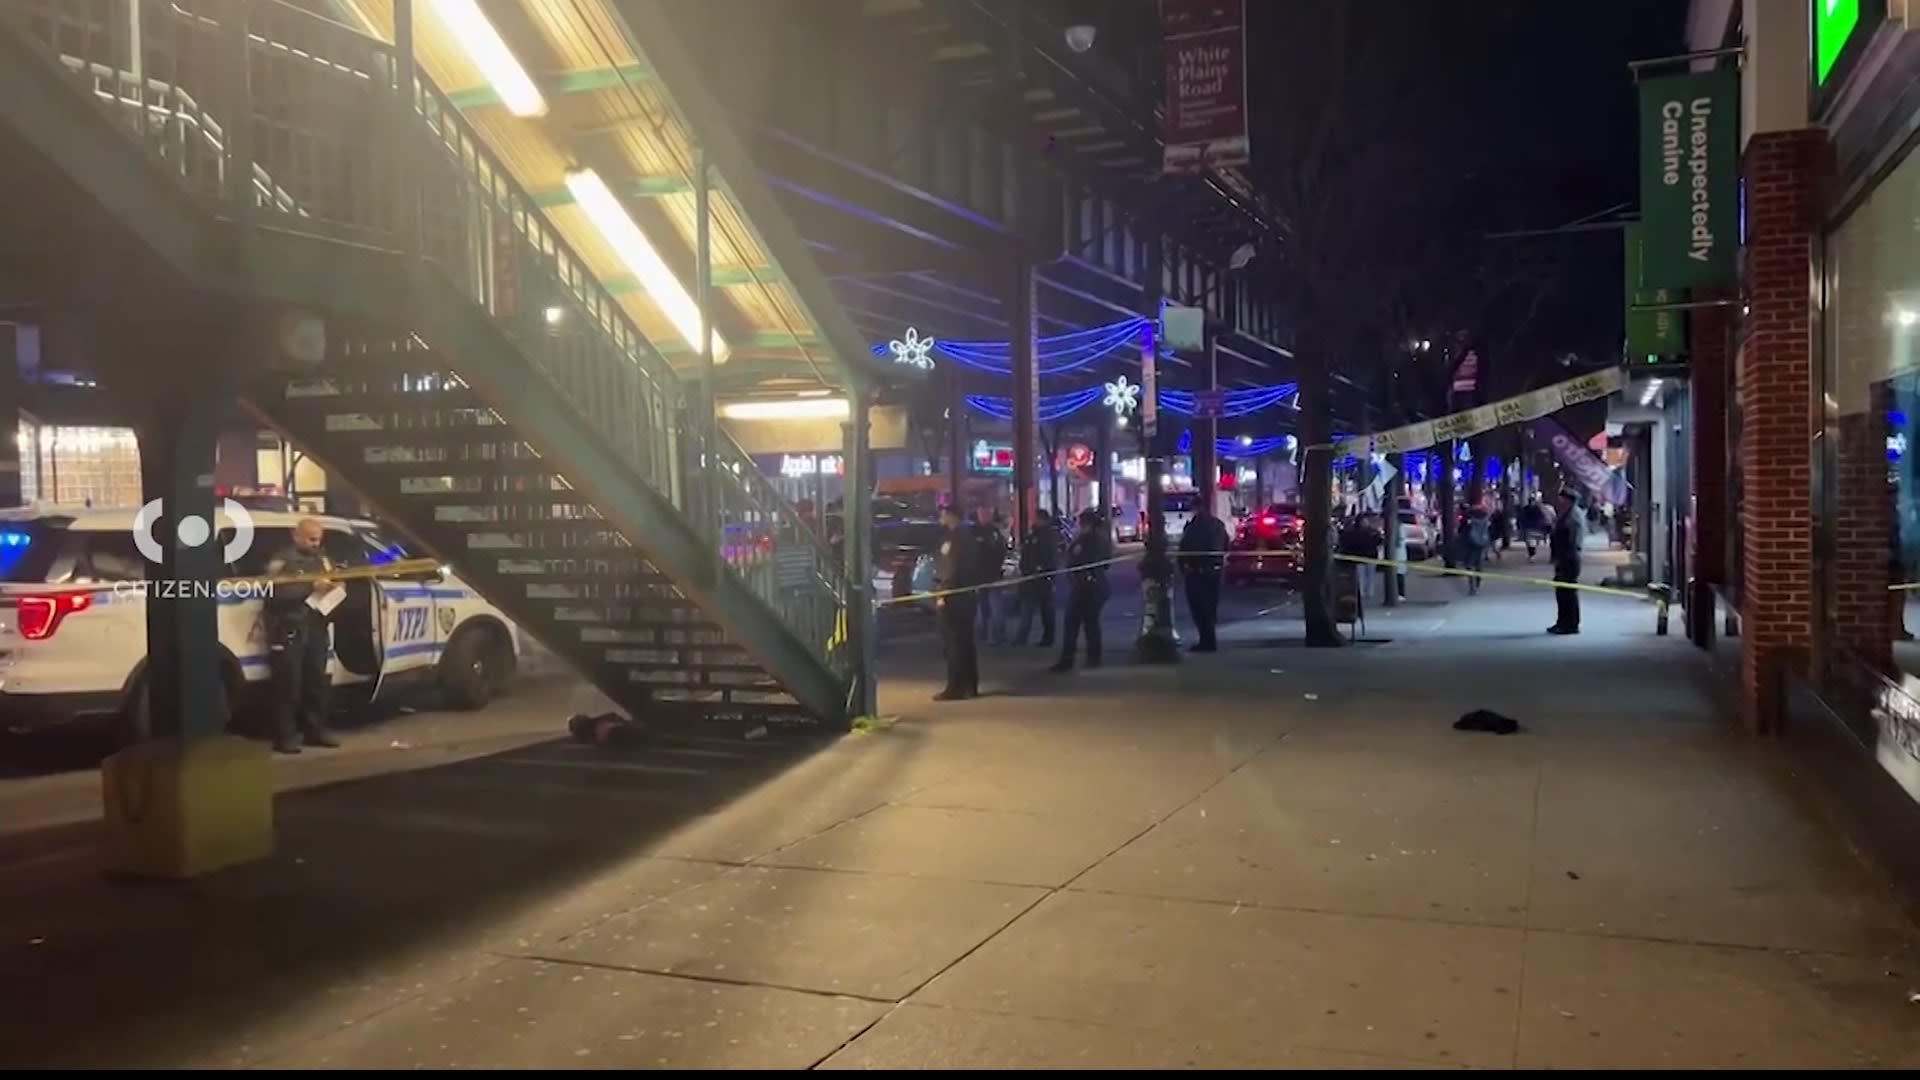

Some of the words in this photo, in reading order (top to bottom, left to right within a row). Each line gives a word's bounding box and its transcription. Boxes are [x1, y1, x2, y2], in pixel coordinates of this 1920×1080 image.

[1178, 47, 1230, 66] White
[1178, 63, 1229, 82] Plains
[1179, 78, 1223, 97] Road
[1662, 101, 1685, 185] Canine
[1688, 97, 1713, 262] Unexpectedly
